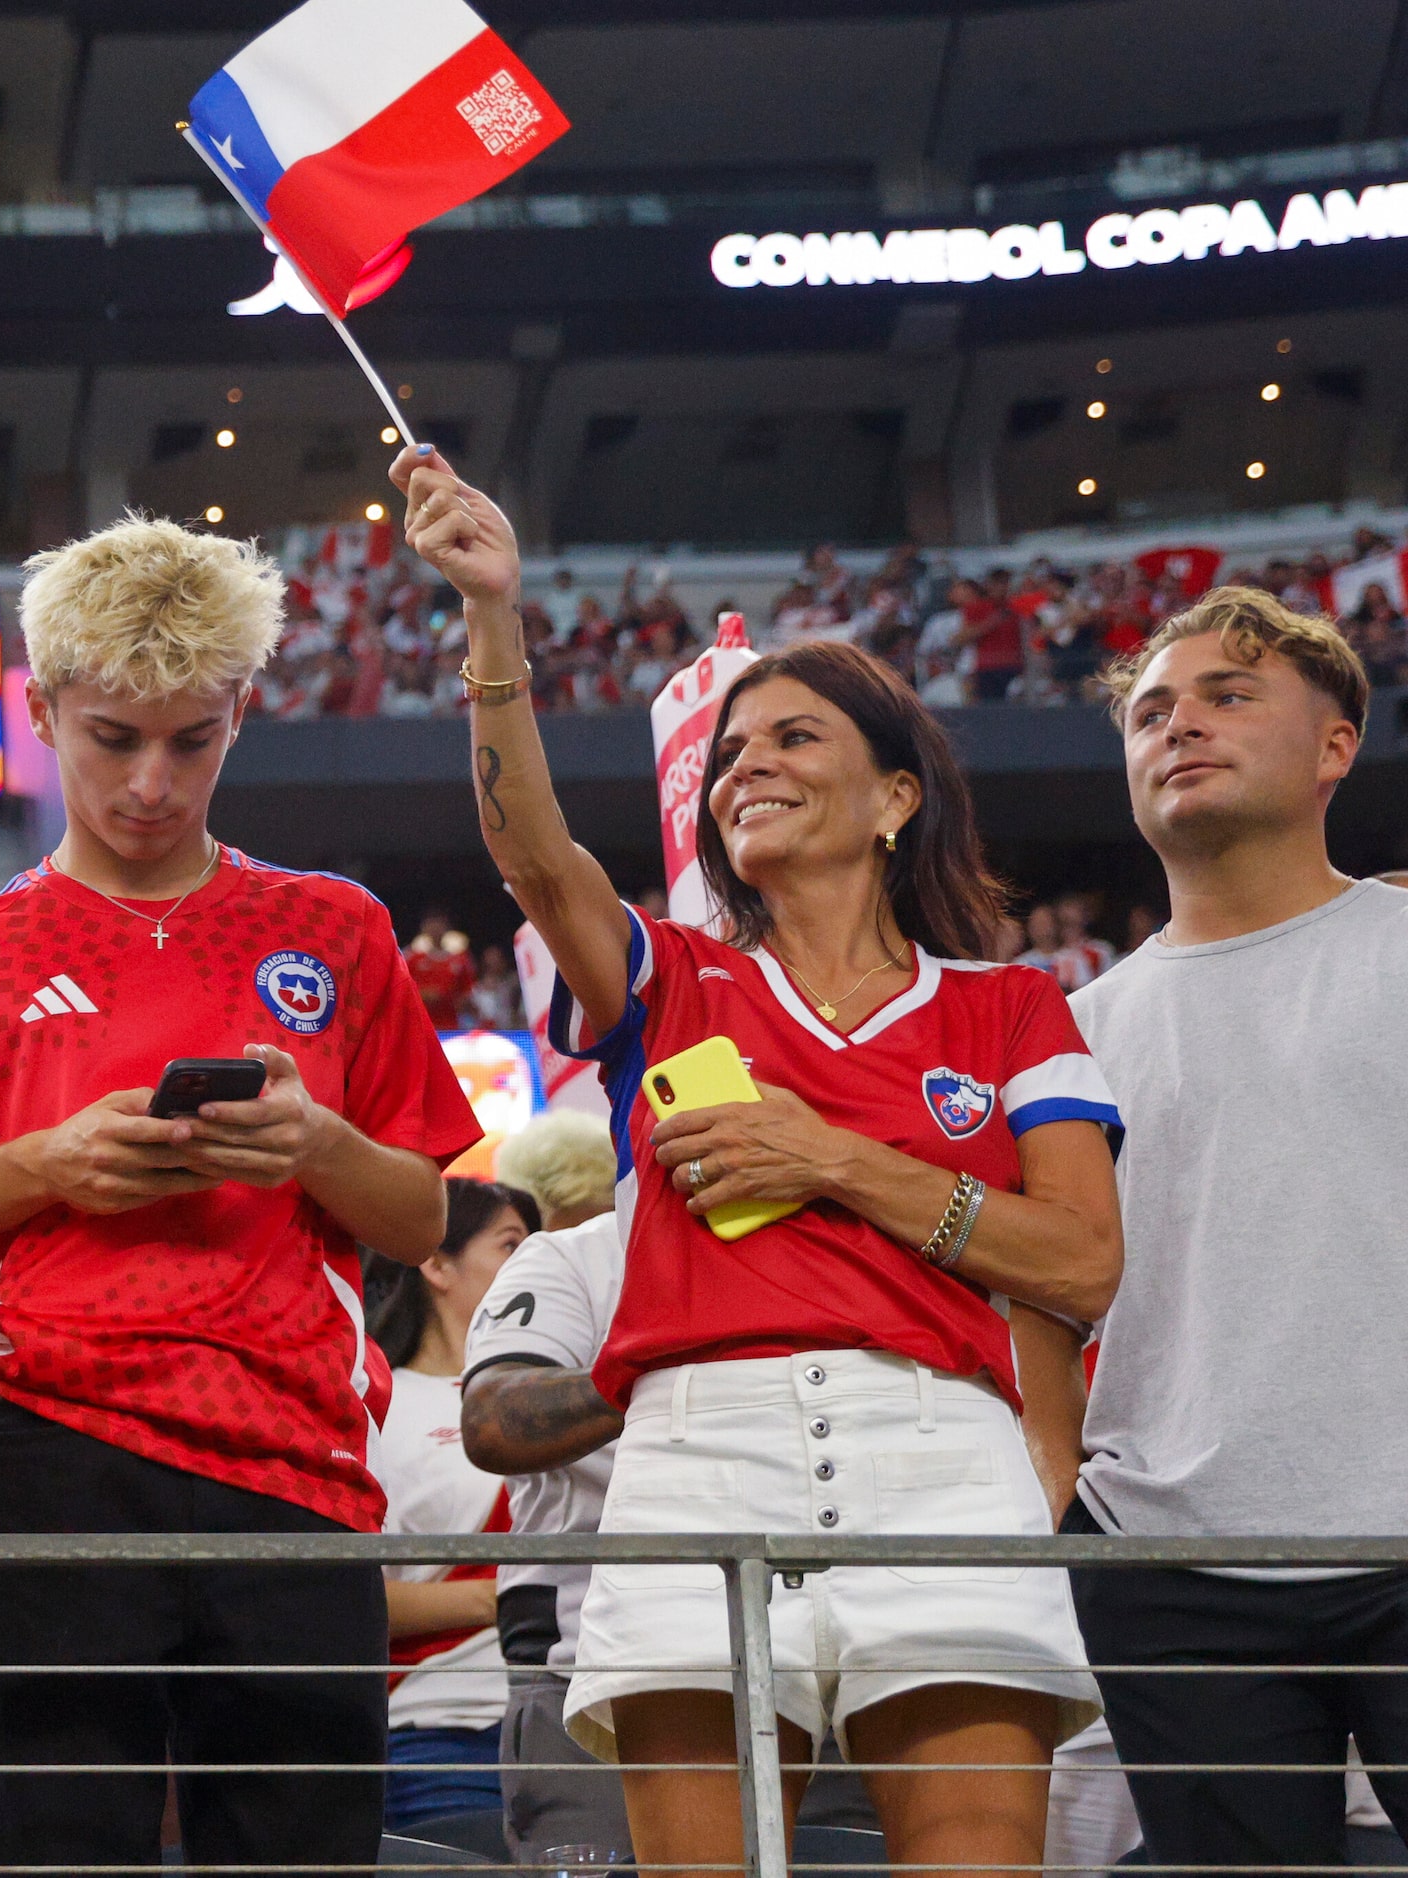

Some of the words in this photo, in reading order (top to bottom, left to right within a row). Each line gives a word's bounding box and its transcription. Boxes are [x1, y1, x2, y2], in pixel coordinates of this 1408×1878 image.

[503, 138, 527, 156] SCAN
[525, 127, 538, 141] ME
[711, 221, 1086, 288] CONMEBOL
[1085, 199, 1277, 270] COPA
[256, 953, 296, 986] FEDERACION
[302, 956, 316, 968] DE
[279, 1013, 291, 1026] DE
[295, 1020, 318, 1032] CHILE
